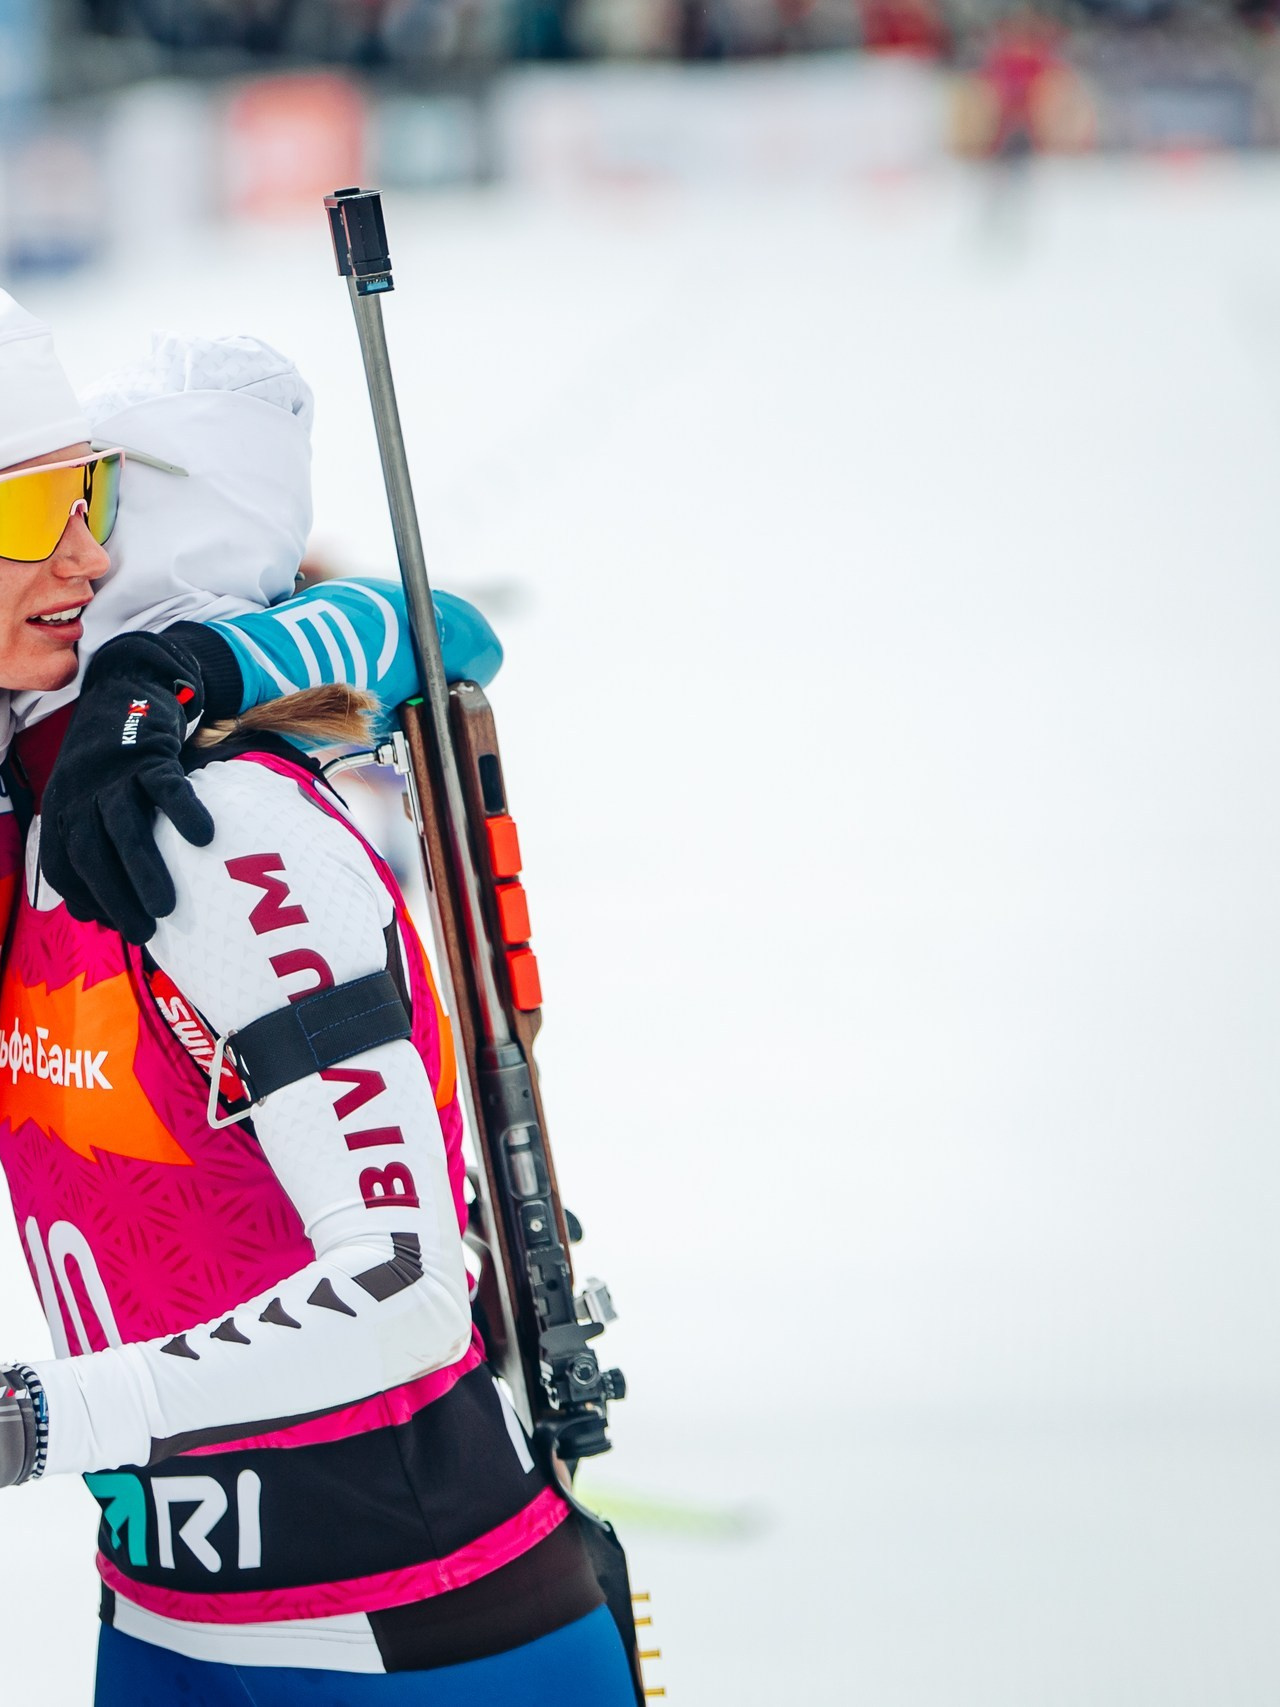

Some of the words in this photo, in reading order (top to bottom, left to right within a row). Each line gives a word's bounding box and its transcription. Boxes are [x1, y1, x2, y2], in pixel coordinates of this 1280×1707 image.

[36, 1026, 113, 1090] Банк
[156, 996, 233, 1078] SWIX
[223, 852, 420, 1209] BIVUM
[85, 1468, 261, 1573] ARI
